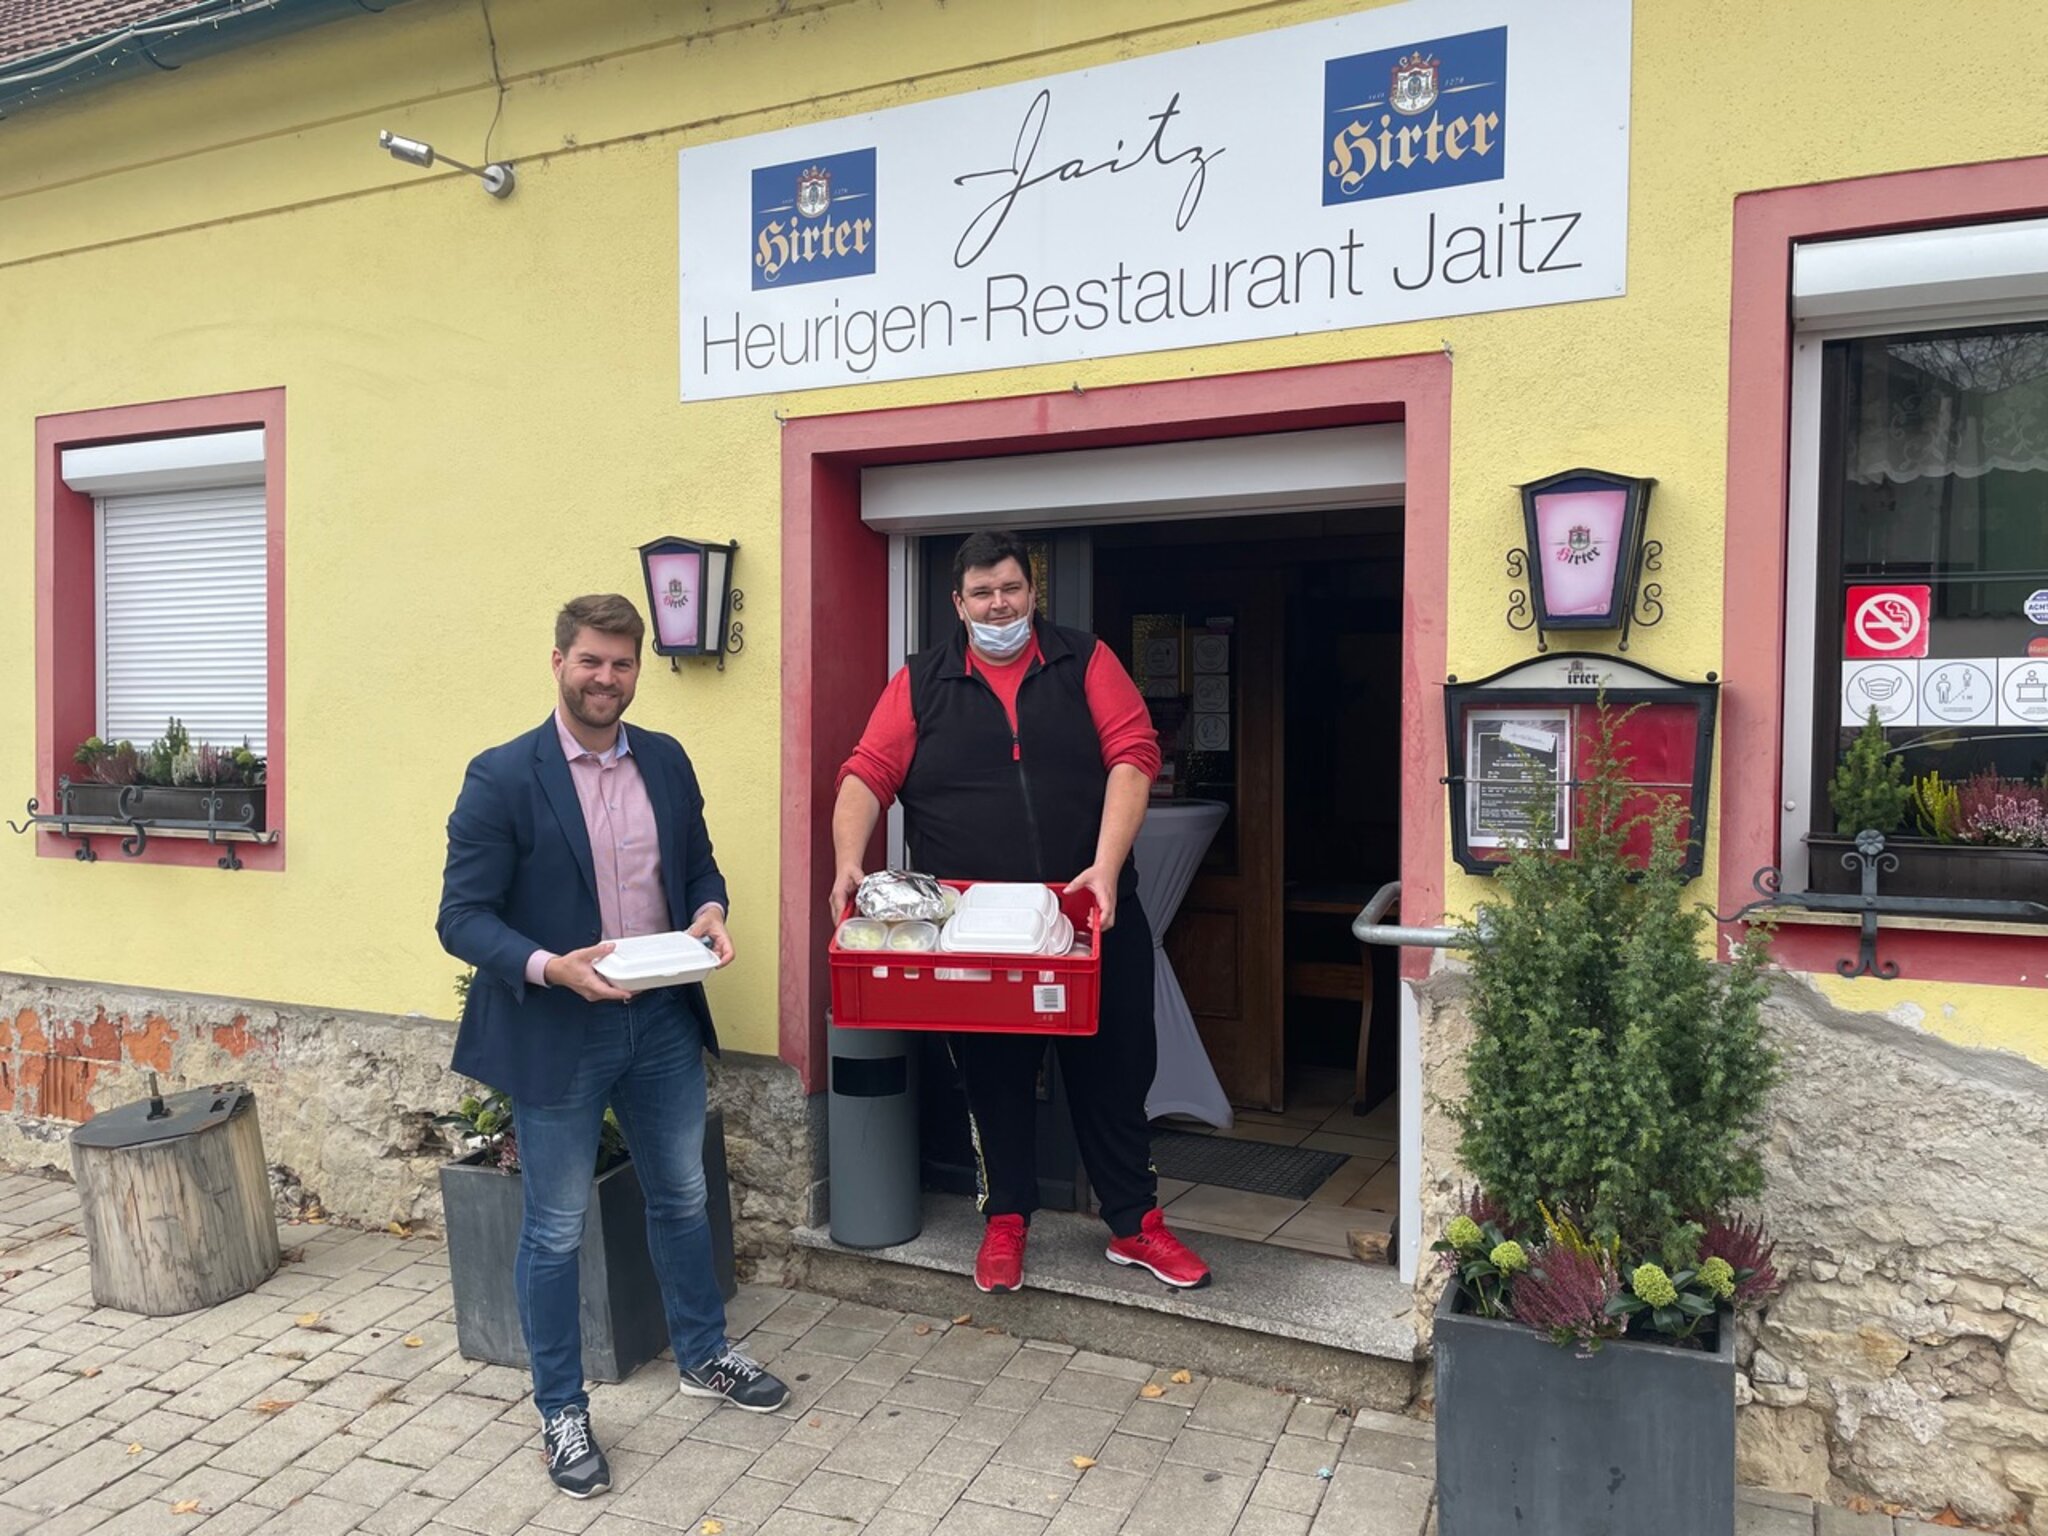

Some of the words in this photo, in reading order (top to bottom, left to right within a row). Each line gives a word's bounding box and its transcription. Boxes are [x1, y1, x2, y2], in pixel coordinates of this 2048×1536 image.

[953, 88, 1226, 269] Jaitz
[1328, 110, 1499, 195] Hirter
[703, 228, 1364, 375] Heurigen-Restaurant
[1393, 203, 1582, 291] Jaitz
[755, 214, 872, 282] Hirter
